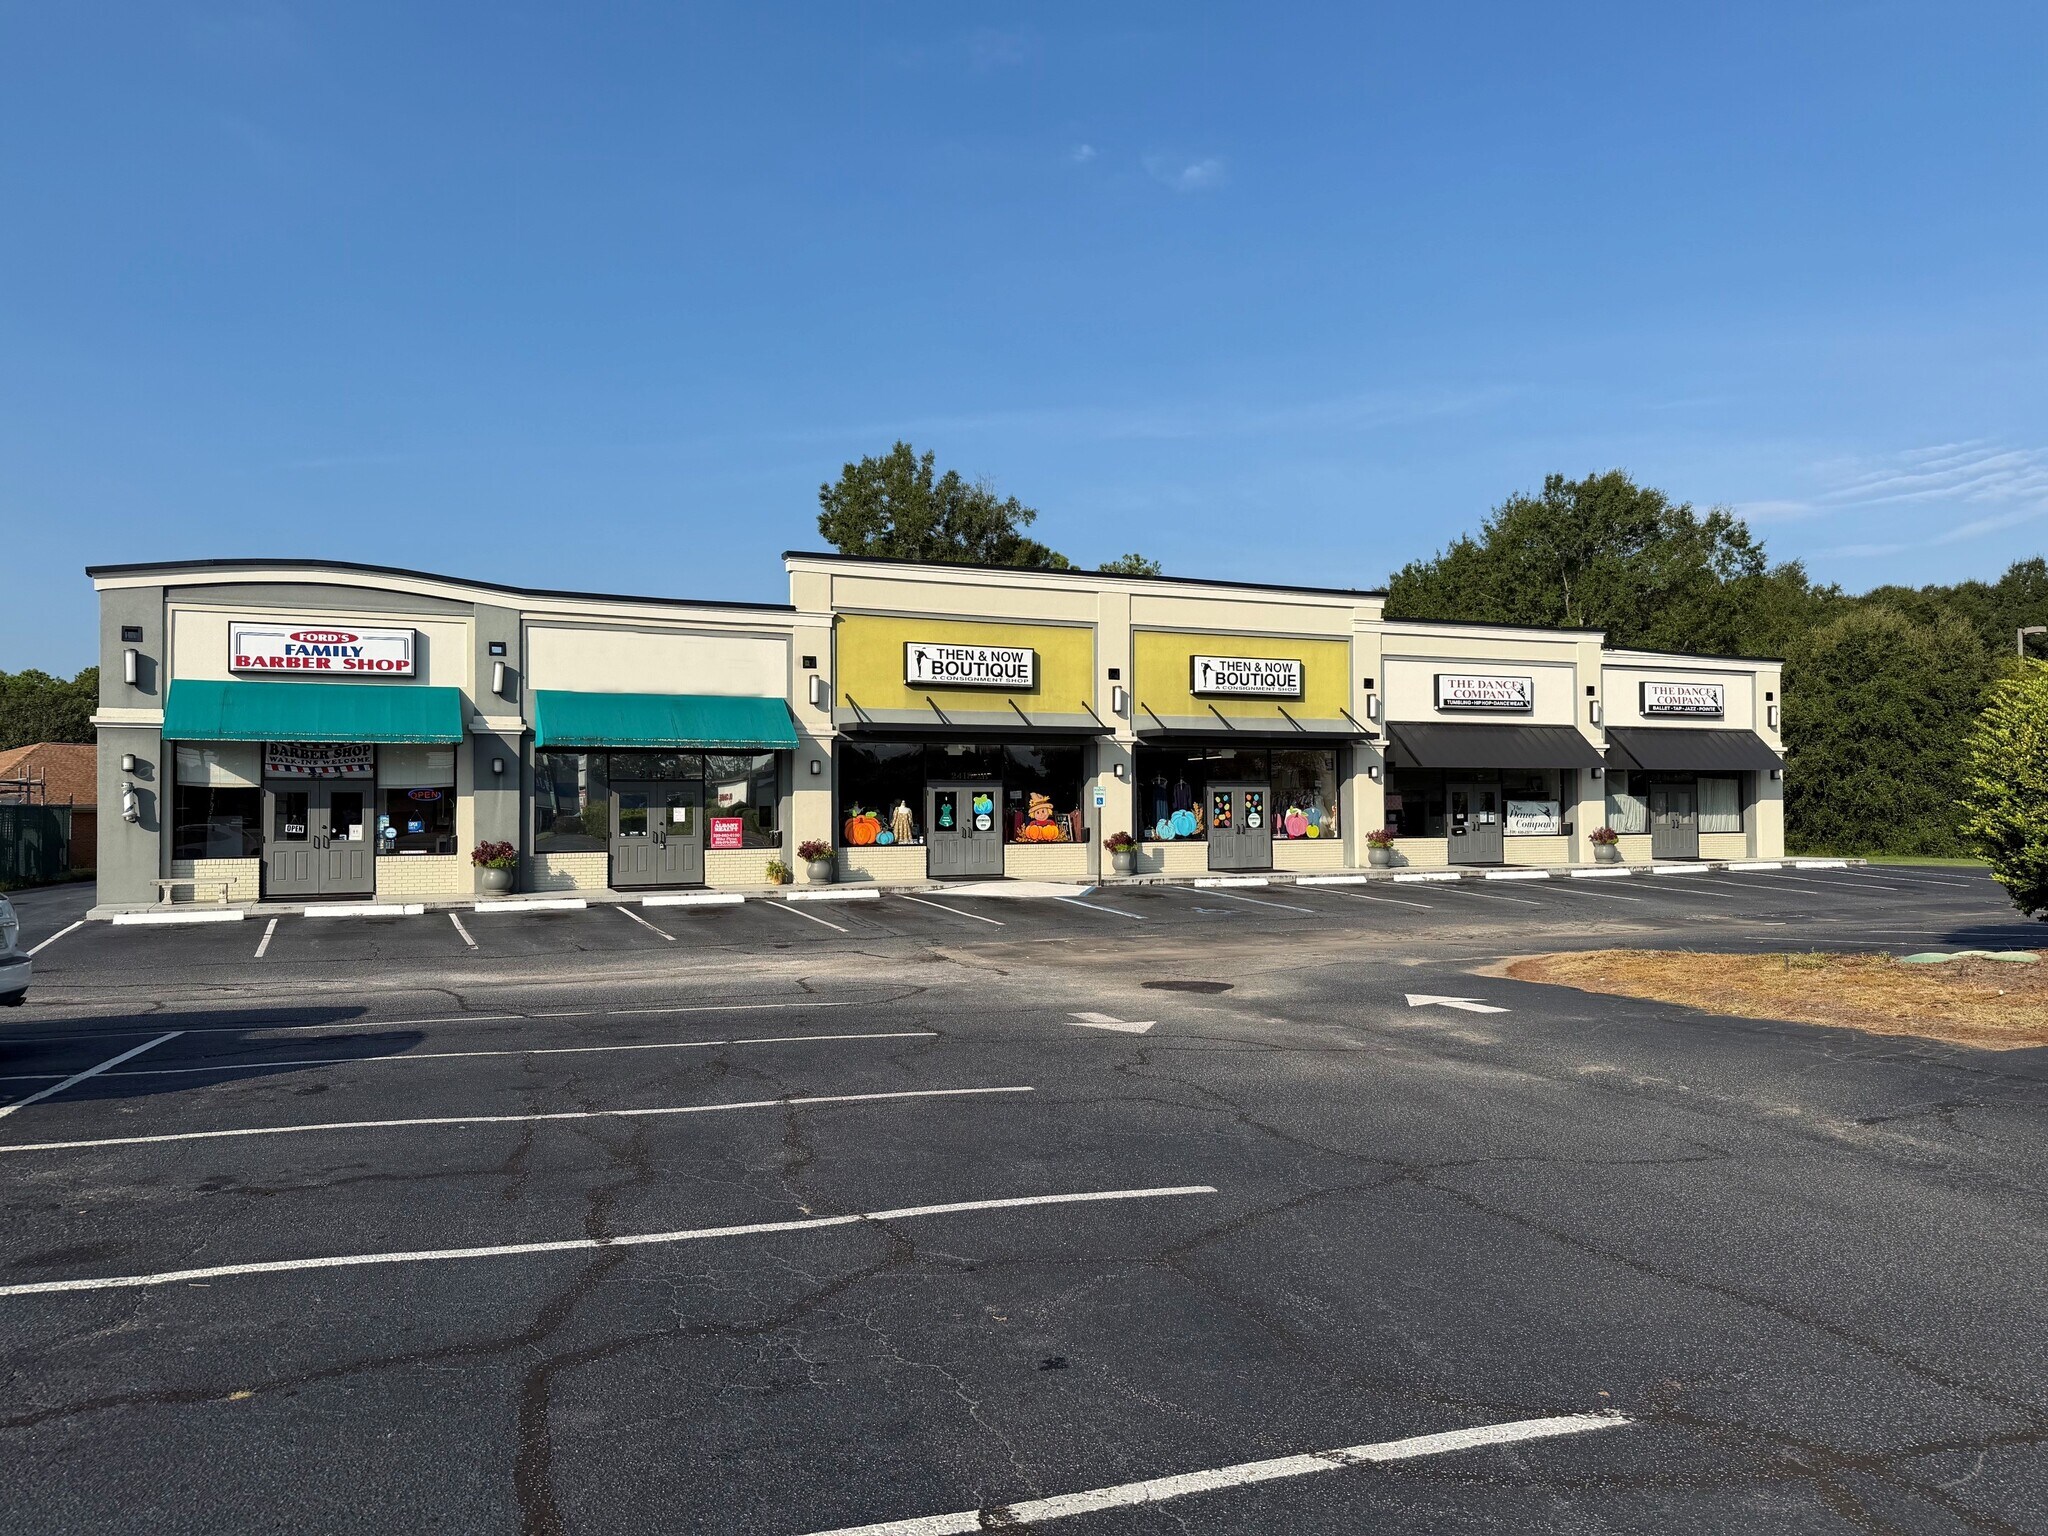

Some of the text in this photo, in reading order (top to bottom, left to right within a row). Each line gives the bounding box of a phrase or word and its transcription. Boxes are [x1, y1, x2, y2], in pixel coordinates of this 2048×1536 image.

[299, 632, 350, 643] FORD'S
[285, 644, 363, 657] FAMILY
[936, 648, 1024, 662] THEN & NOW
[235, 655, 410, 671] BARBER SHOP
[1219, 661, 1293, 673] THEN & NOW
[931, 660, 1028, 678] BOUTIQUE
[940, 675, 1003, 683] CONSIGNMENT
[1215, 672, 1297, 687] BOUTIQUE
[1447, 679, 1519, 689] THE DANCE
[1453, 689, 1513, 699] COMPANY
[1652, 686, 1712, 695] THE DANCE
[1657, 696, 1707, 705] COMPANY
[269, 743, 371, 760] BARBER SHOP
[270, 756, 370, 765] WALK-INS WELCOME
[411, 791, 438, 799] OPEN
[1509, 809, 1537, 818] Dance
[286, 824, 304, 833] OPEN
[1516, 820, 1556, 830] Company
